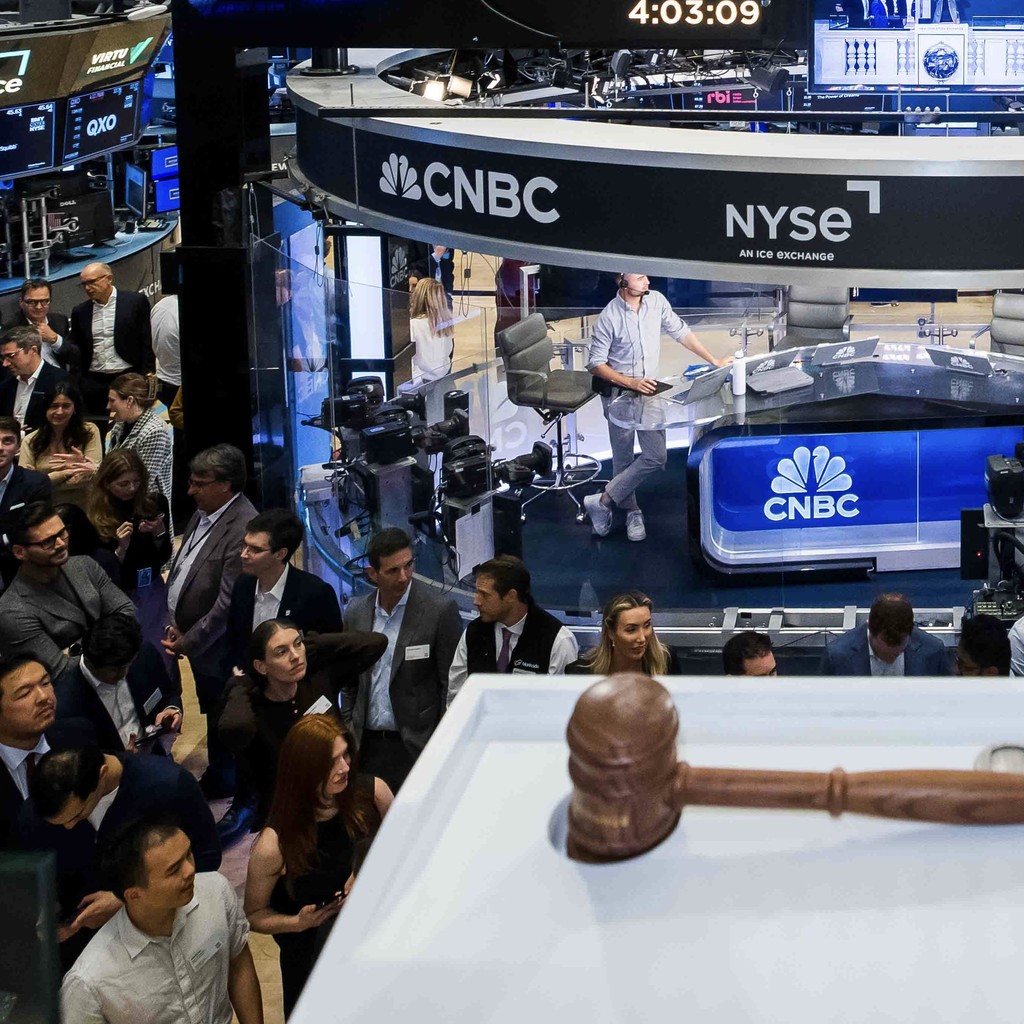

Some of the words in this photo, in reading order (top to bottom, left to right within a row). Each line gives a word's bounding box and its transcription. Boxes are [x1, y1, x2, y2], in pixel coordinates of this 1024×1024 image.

[628, 0, 760, 25] 4:03:09
[92, 47, 129, 65] VIRTU
[86, 60, 126, 75] FINANCIAL
[707, 90, 731, 104] rbi
[86, 114, 117, 136] QXO
[272, 163, 288, 171] EW
[423, 161, 561, 223] CNBC
[739, 249, 752, 259] AN
[763, 493, 860, 522] CNBC
